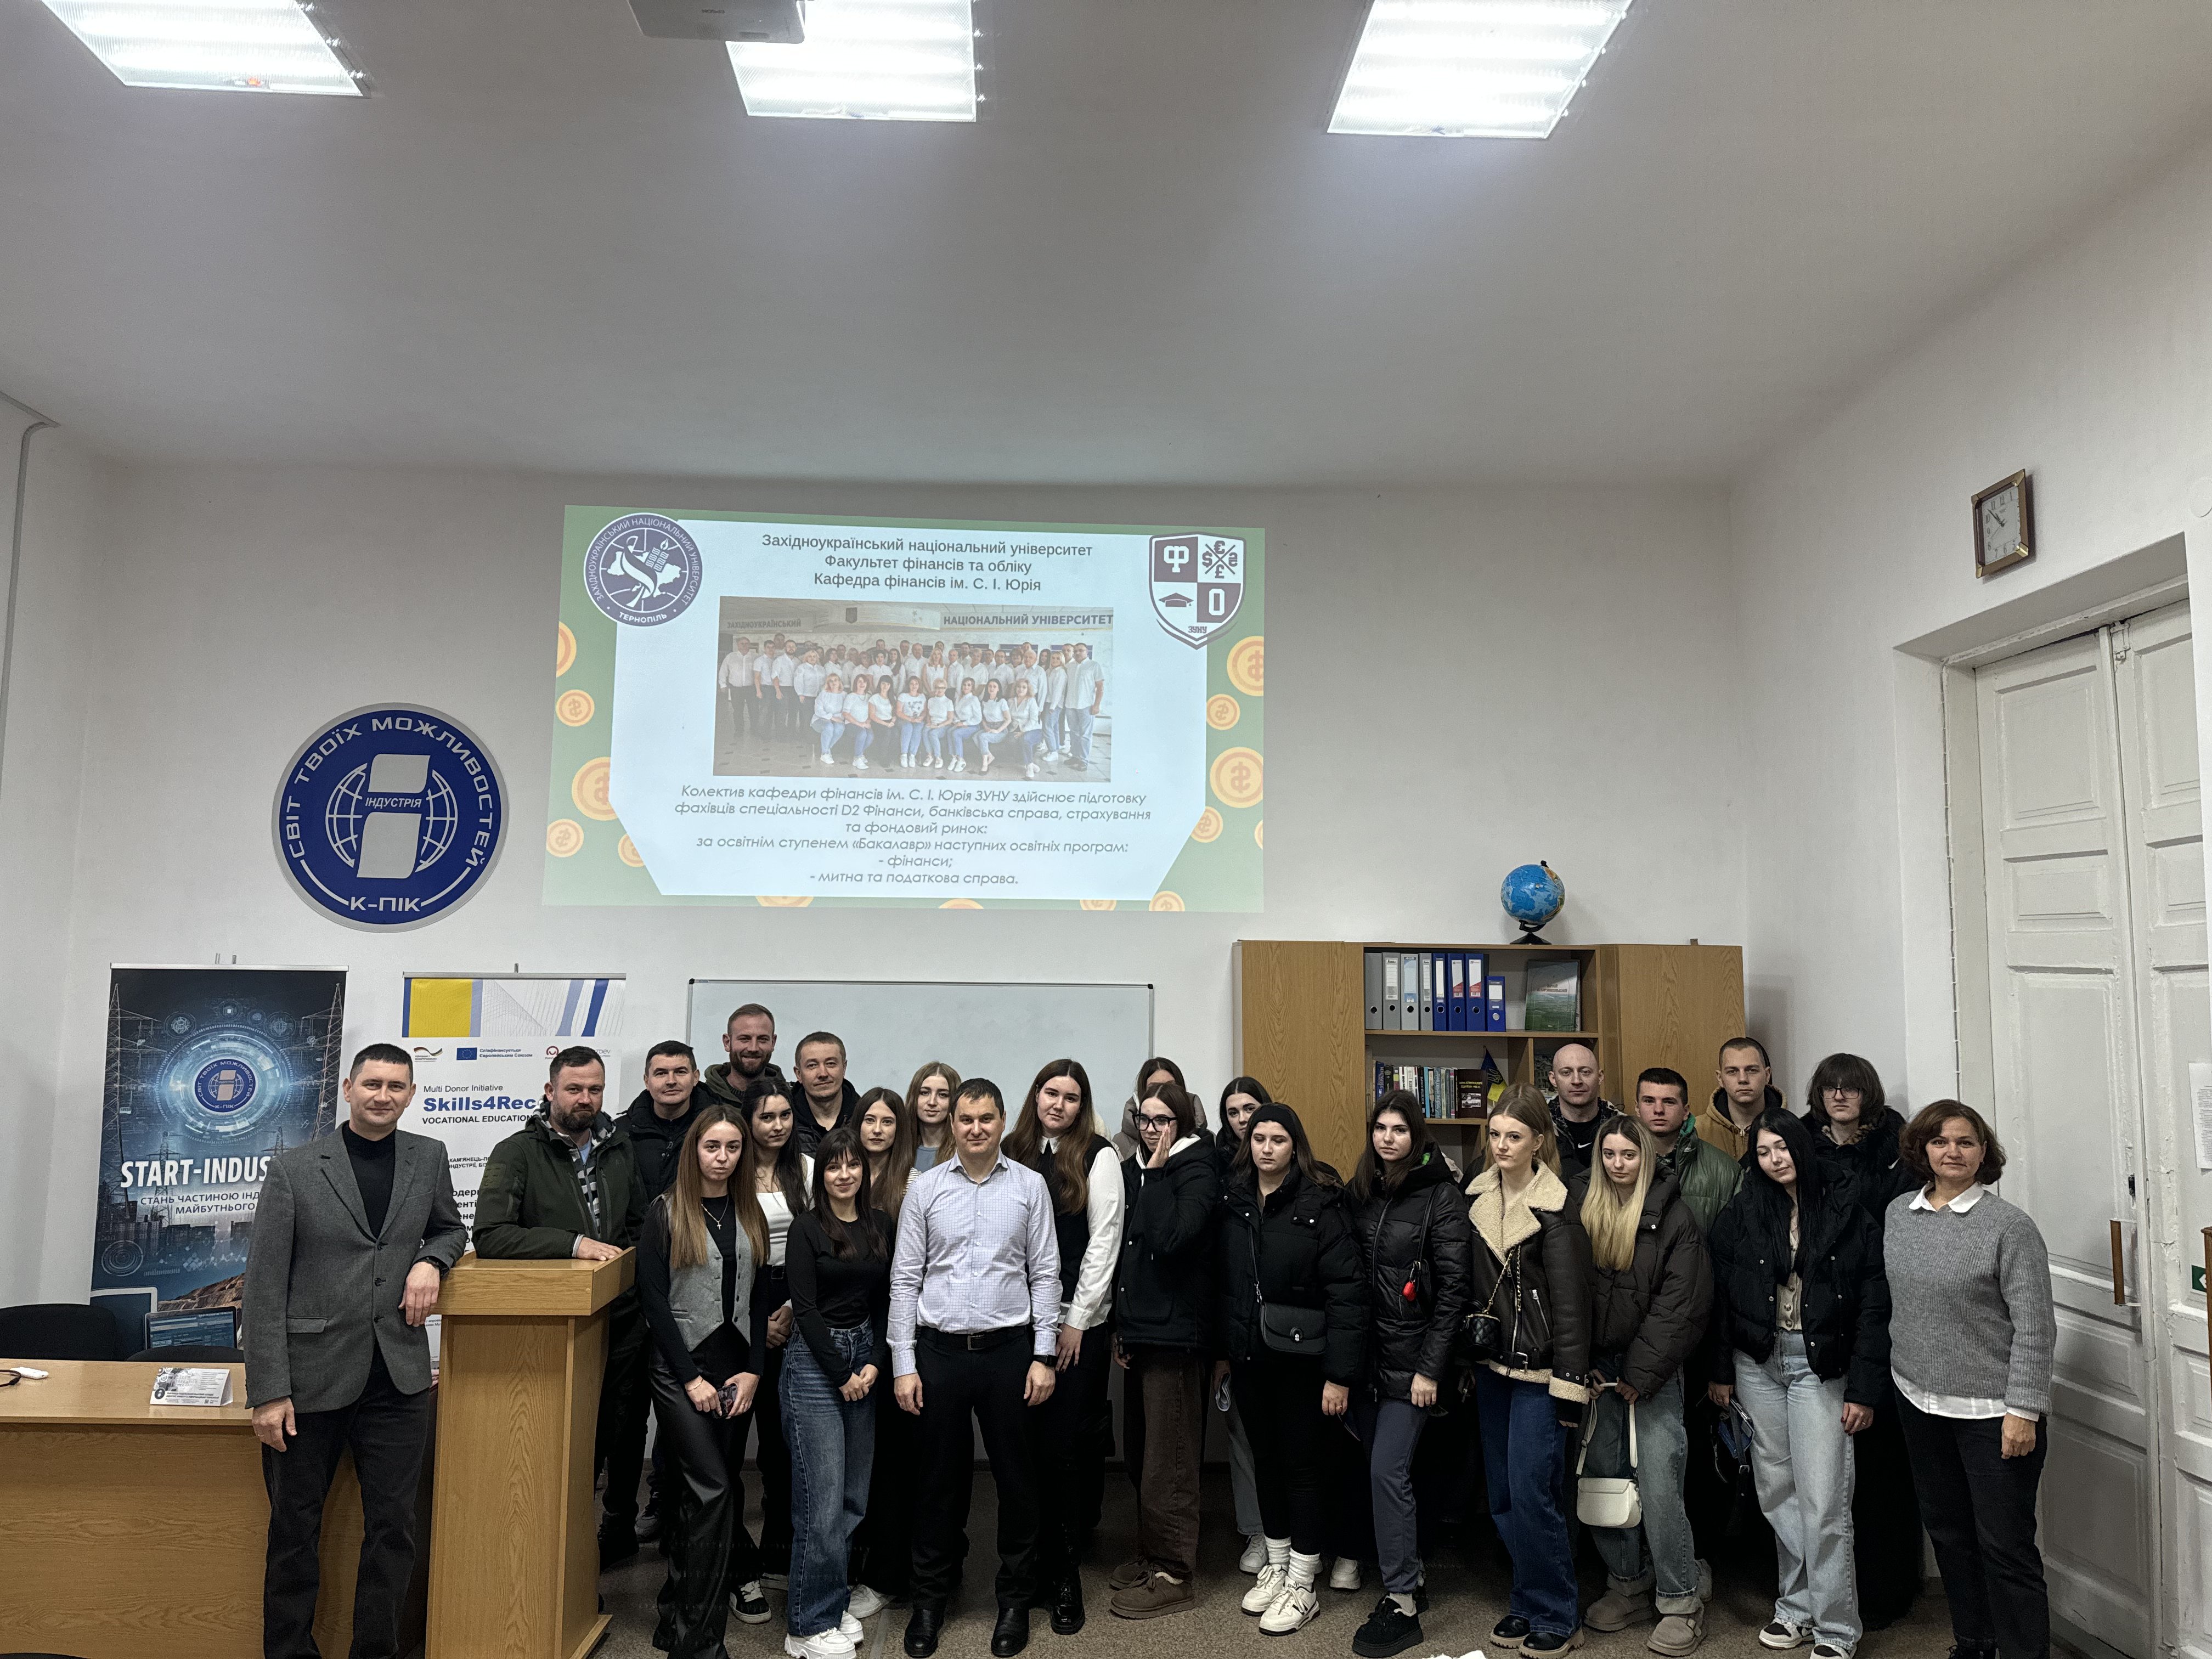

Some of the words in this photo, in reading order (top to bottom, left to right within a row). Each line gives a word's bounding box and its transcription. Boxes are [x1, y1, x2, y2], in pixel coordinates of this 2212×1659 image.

[762, 534, 904, 551] Західноукраїнський
[909, 540, 1006, 555] національний
[1011, 543, 1092, 558] університет
[589, 520, 630, 601] ЗАХІДНОУКРАЇНСЬКИЙ
[631, 517, 694, 552] НАЦІОНАЛЬНИЙ
[681, 551, 699, 605] УНІВЕРСИТЕТ
[825, 555, 898, 570] Факультет
[902, 557, 964, 572] фінансів
[968, 561, 984, 571] та
[988, 560, 1031, 575] обліку
[814, 573, 880, 588] Кафедра
[884, 575, 945, 589] фінансів
[950, 577, 968, 589] ім.
[973, 578, 988, 590] С.
[993, 579, 1001, 590] І.
[1006, 579, 1041, 593] Юрія
[619, 612, 667, 623] ТЕРНОПІЛЬ
[727, 618, 801, 629] ЗАХІДНОУКРАЇНСЬКИЙ
[944, 613, 1029, 626] НАЦІОНАЛЬНИЙ
[1031, 614, 1113, 624] УНІВЕРСИТЕТ
[294, 723, 363, 785] ТВОЇХ
[371, 717, 493, 867] МОЖЛИВОСТЕЙ
[681, 785, 744, 797] Колектив
[748, 787, 816, 800] кафедри
[820, 788, 883, 801] фінансів
[887, 789, 904, 800] ім.
[909, 789, 923, 800] С.
[938, 789, 972, 803] Юрія
[975, 791, 1010, 802] ЗУНУ
[1012, 791, 1075, 803] здійснює
[1079, 792, 1147, 805] підготовку
[365, 797, 422, 809] ІНДУСТРІЯ
[675, 802, 735, 815] фахівців
[739, 803, 838, 815] спеціальності
[842, 805, 860, 816] D2
[864, 805, 924, 817] Фінанси,
[929, 806, 1003, 817] банківська
[1008, 809, 1062, 821] справа,
[1066, 810, 1151, 822] страхування
[286, 795, 305, 859] СВІТ
[846, 823, 860, 832] та
[865, 822, 938, 834] фондовий
[941, 824, 988, 836] ринок:
[696, 838, 713, 847] за
[717, 836, 774, 847] освітнім
[778, 839, 848, 850] ступенем
[853, 838, 931, 852] «Бакалавр»
[934, 840, 1006, 853] наступних
[1010, 840, 1060, 851] освітніх
[1063, 843, 1128, 854] програм:
[888, 855, 953, 868] фінанси;
[819, 873, 863, 883] митна
[867, 873, 882, 883] та
[887, 873, 959, 884] податкова
[963, 874, 1018, 886] справа.
[350, 896, 422, 912] К-ПІК
[199, 1063, 218, 1079] ТВОЇХ
[220, 1061, 253, 1097] МОЖЛИВОСТЕЙ
[424, 1096, 536, 1111] Skills4Rec
[422, 1116, 479, 1124] VOCATIONAL
[120, 1155, 273, 1188] START-INDUS
[140, 1193, 174, 1205] СТАНЬ
[177, 1192, 239, 1203] ЧАСТИНОЮ
[242, 1192, 259, 1200] ІНД
[176, 1203, 255, 1214] МАЙБУТНЬОГО
